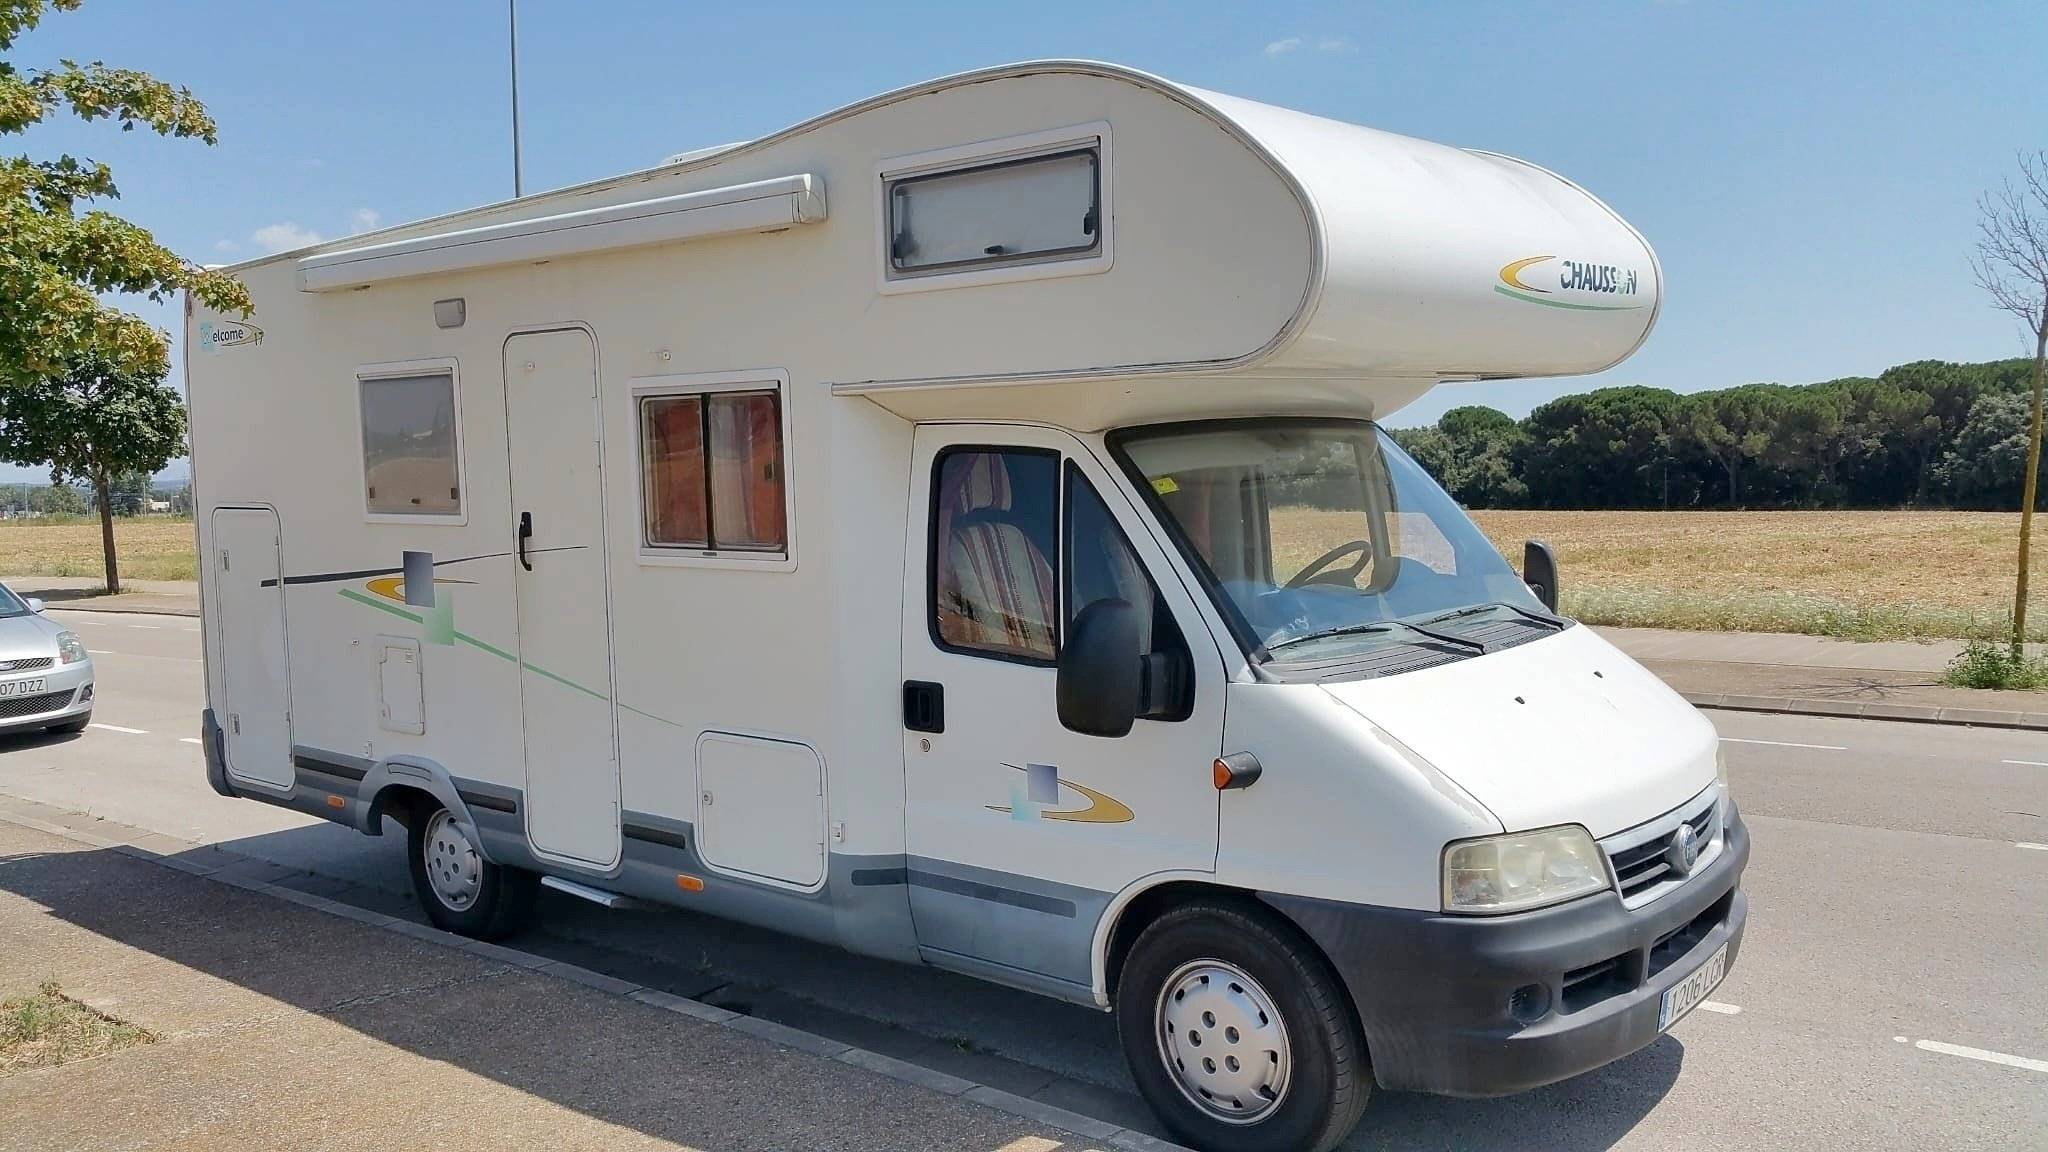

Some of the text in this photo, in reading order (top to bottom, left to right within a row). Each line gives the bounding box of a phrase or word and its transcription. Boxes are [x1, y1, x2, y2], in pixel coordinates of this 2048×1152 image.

[1560, 260, 1637, 295] CHAUSSON
[20, 680, 44, 693] DZZ
[1671, 973, 1702, 1018] 1206
